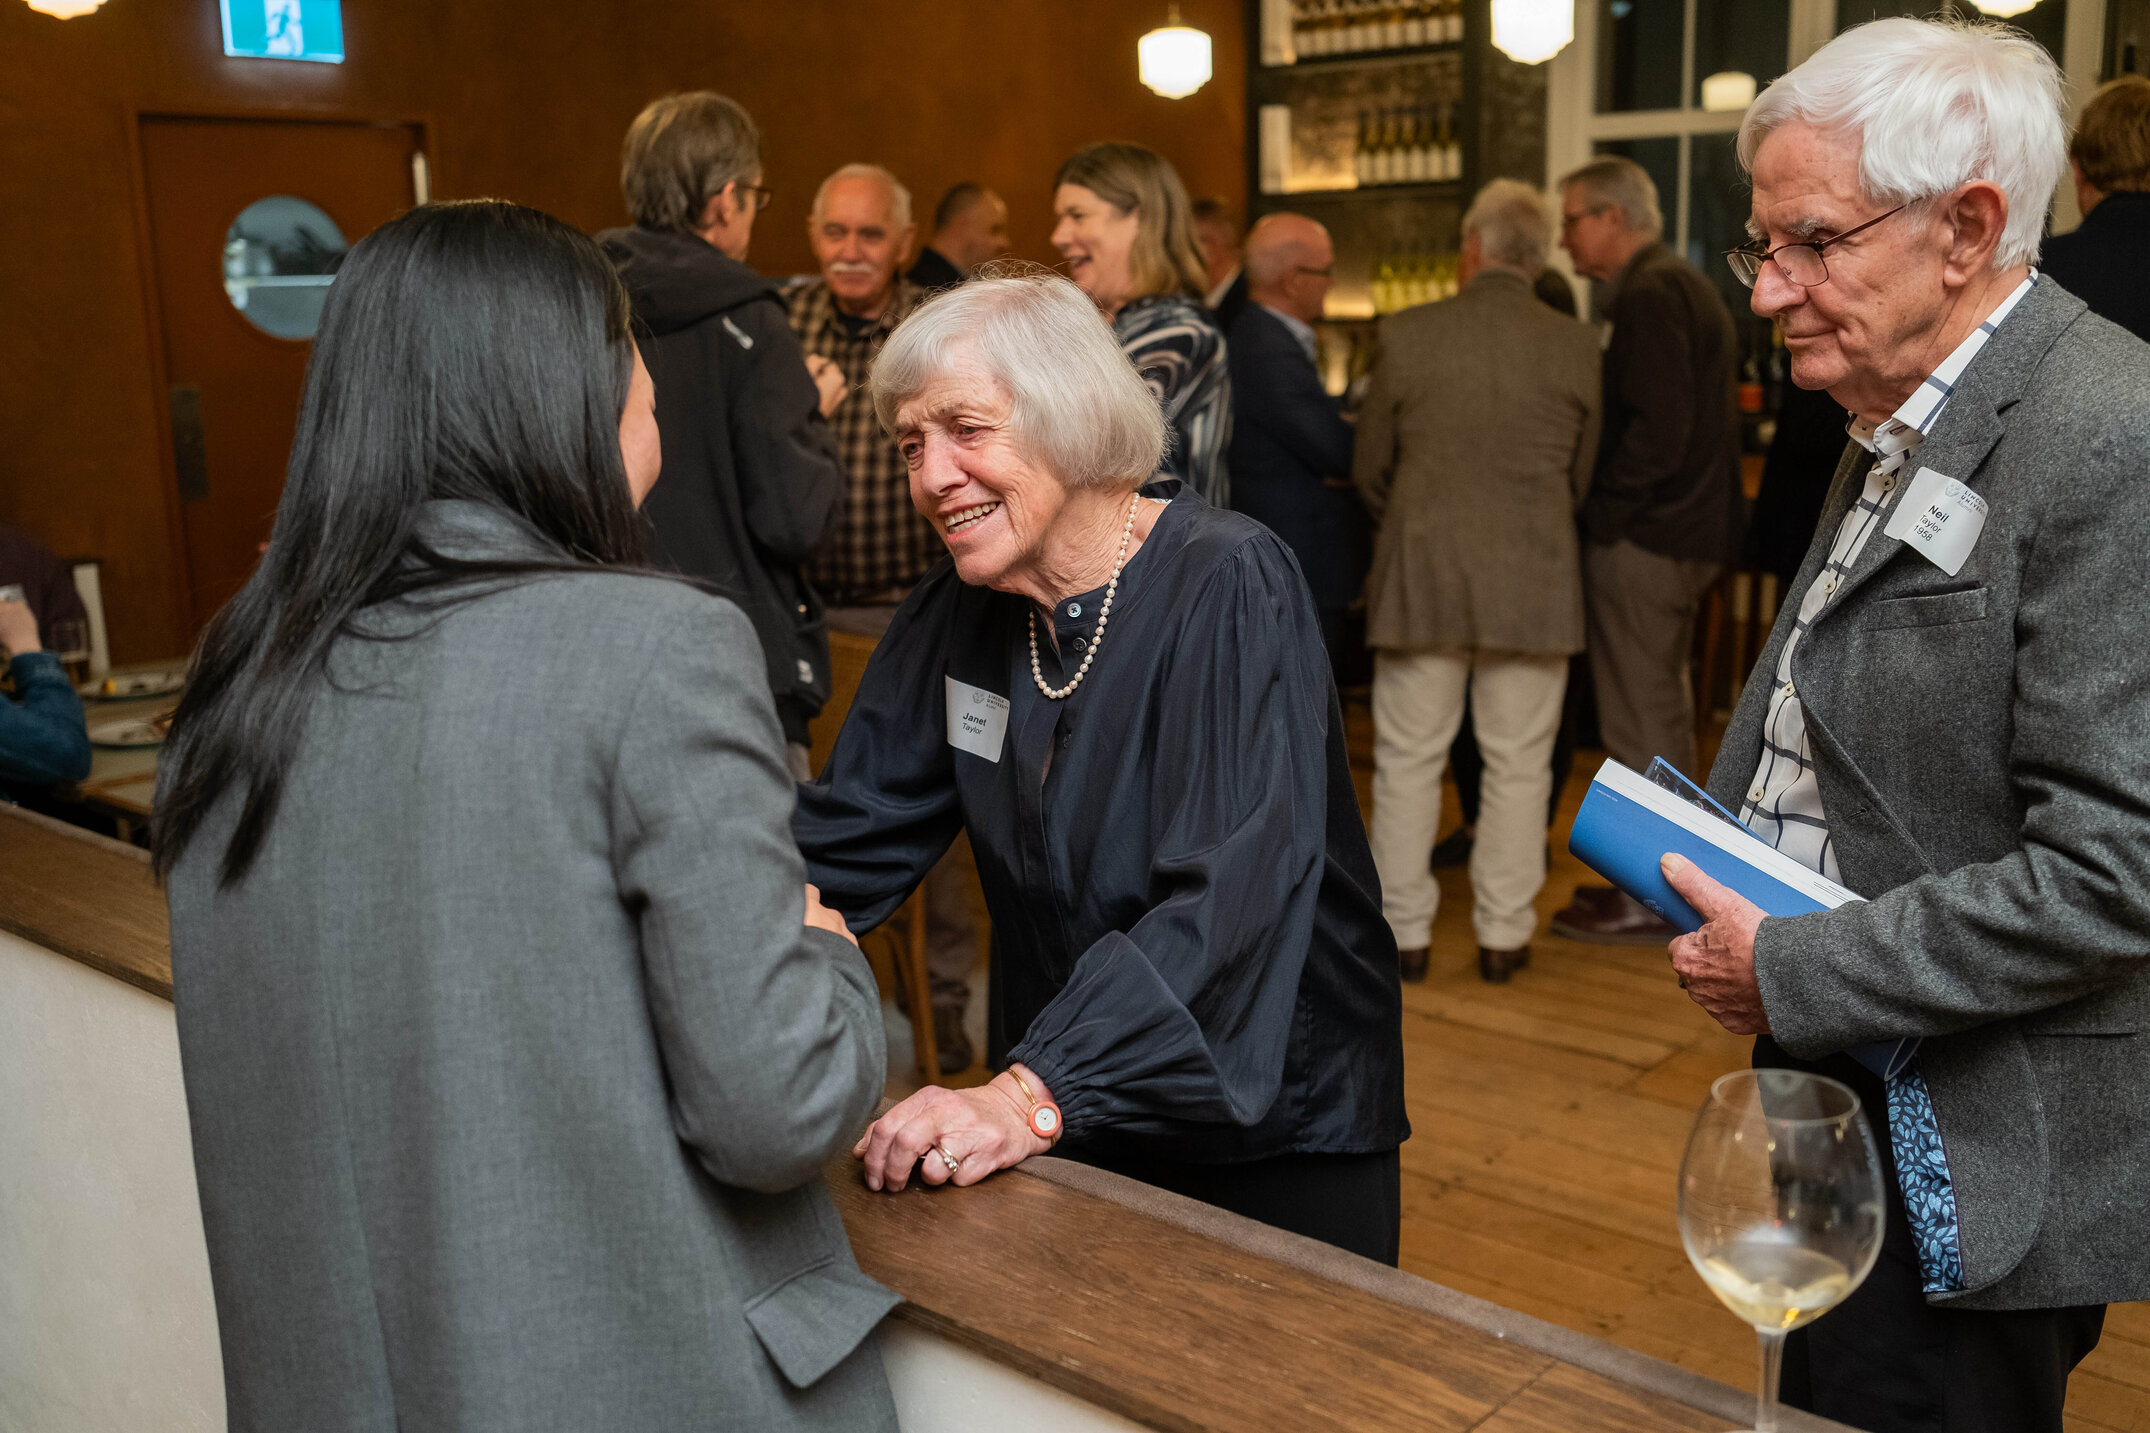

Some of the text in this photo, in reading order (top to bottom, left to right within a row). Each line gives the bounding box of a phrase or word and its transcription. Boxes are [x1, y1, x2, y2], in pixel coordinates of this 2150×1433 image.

[1928, 504, 1950, 523] Neil
[1919, 514, 1942, 534] Taylor
[1913, 525, 1933, 542] 1958
[962, 713, 987, 727] Janet
[962, 722, 983, 735] Taylor
